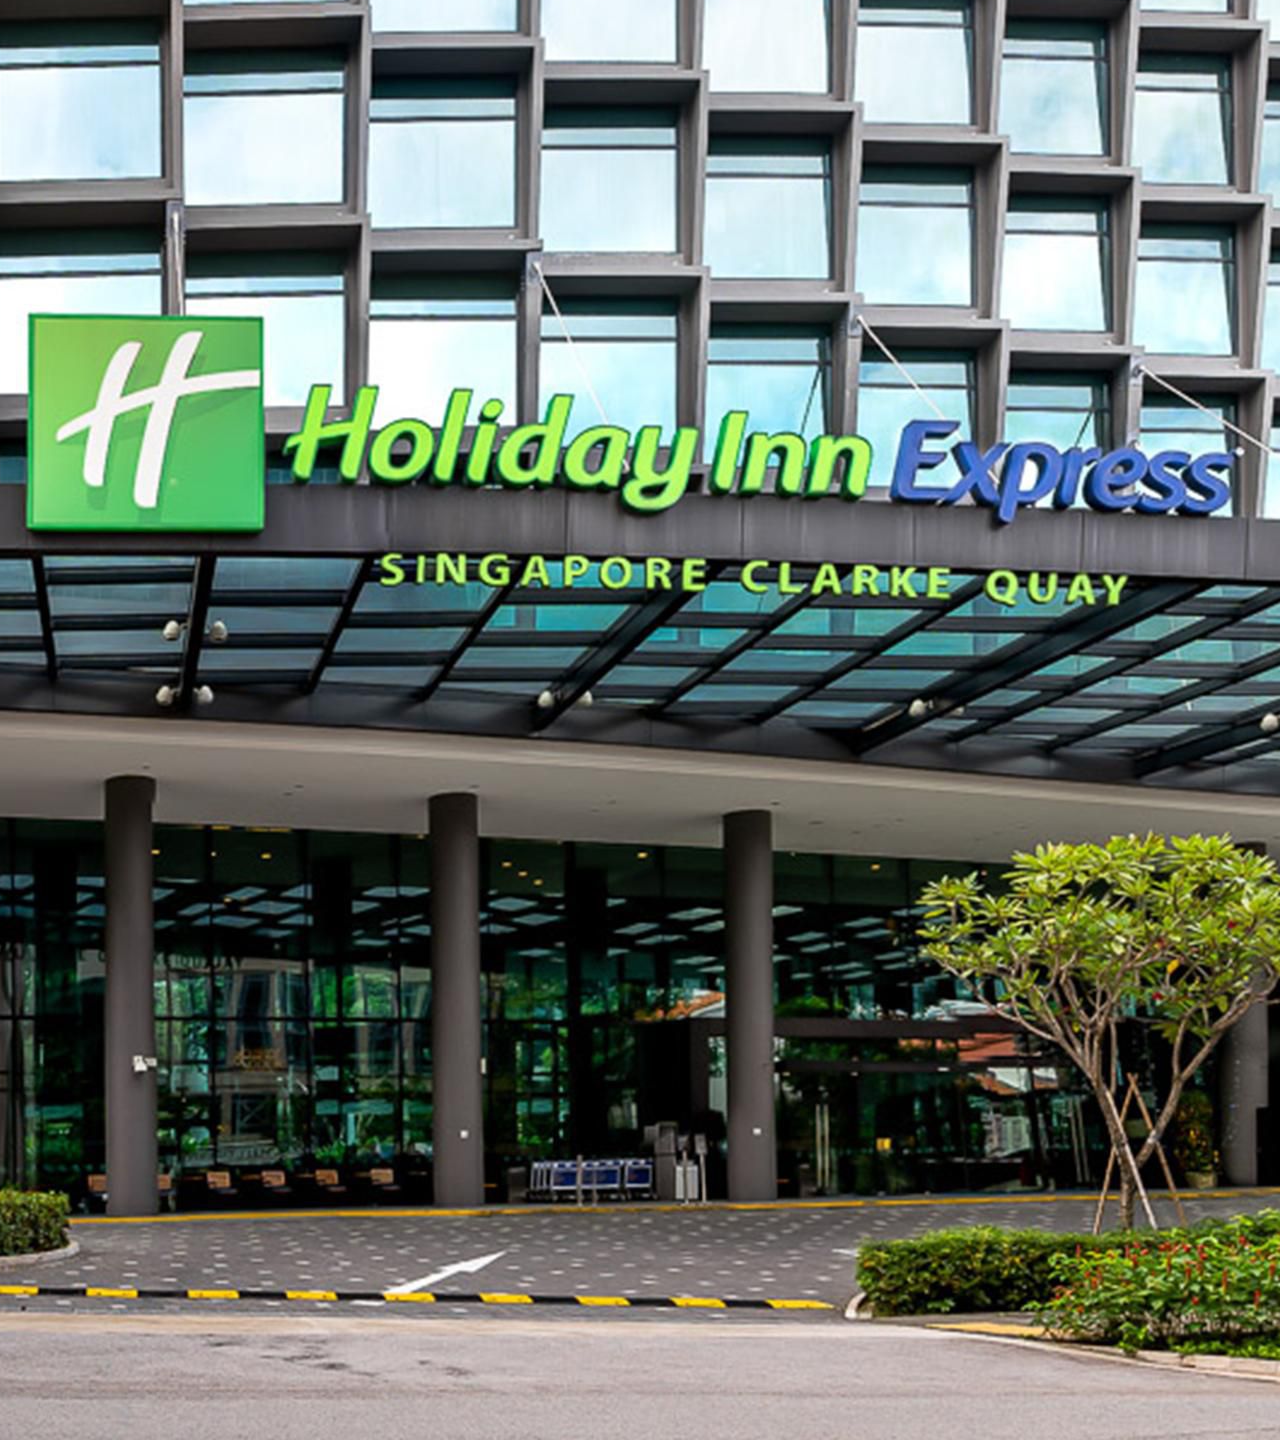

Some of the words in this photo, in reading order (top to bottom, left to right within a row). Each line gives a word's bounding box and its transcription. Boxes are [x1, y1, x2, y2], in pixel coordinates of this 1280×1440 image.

[283, 383, 699, 514] Holiday
[708, 410, 873, 501] Inn
[889, 420, 1236, 524] Express
[380, 553, 707, 592] SINGAPORE
[740, 560, 951, 600] CLARKE
[984, 570, 1128, 606] QUAY
